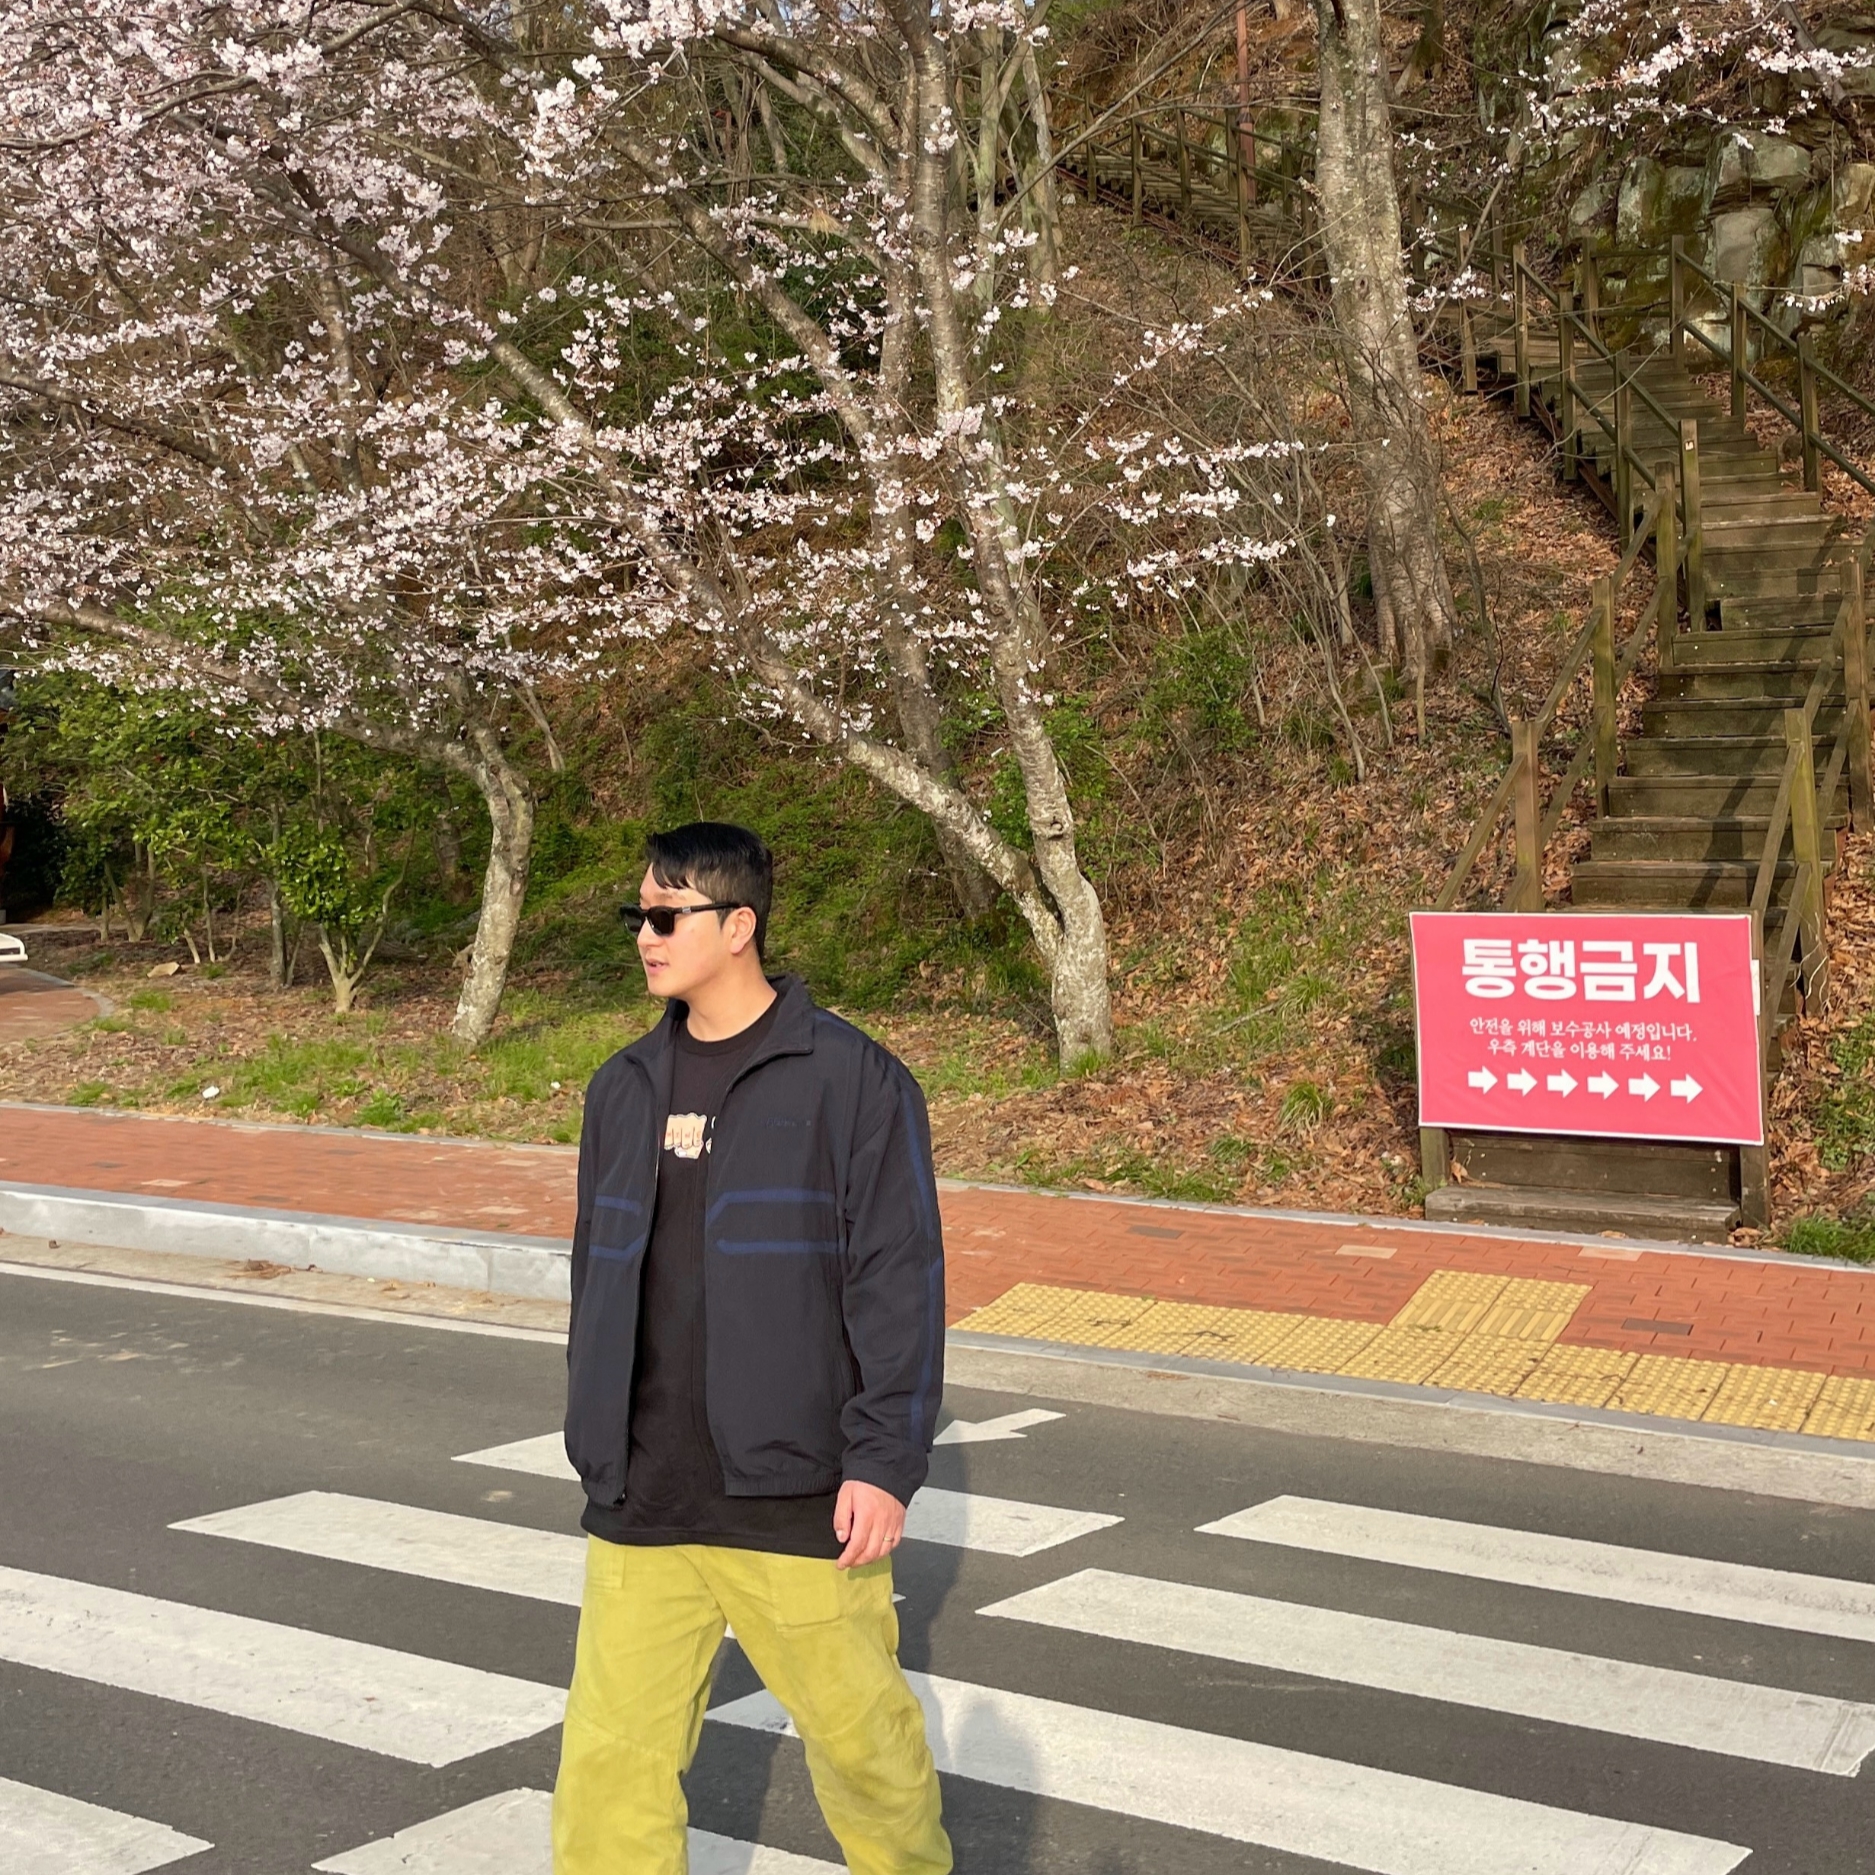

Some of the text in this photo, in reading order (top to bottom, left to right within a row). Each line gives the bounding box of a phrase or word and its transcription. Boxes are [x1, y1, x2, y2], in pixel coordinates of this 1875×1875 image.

[1462, 938, 1701, 1004] 통행금지
[1469, 1016, 1698, 1042] 안전을 위해 보수공사 예정입니다.
[1487, 1038, 1672, 1062] 우측 계단을 이용해 주세요!
